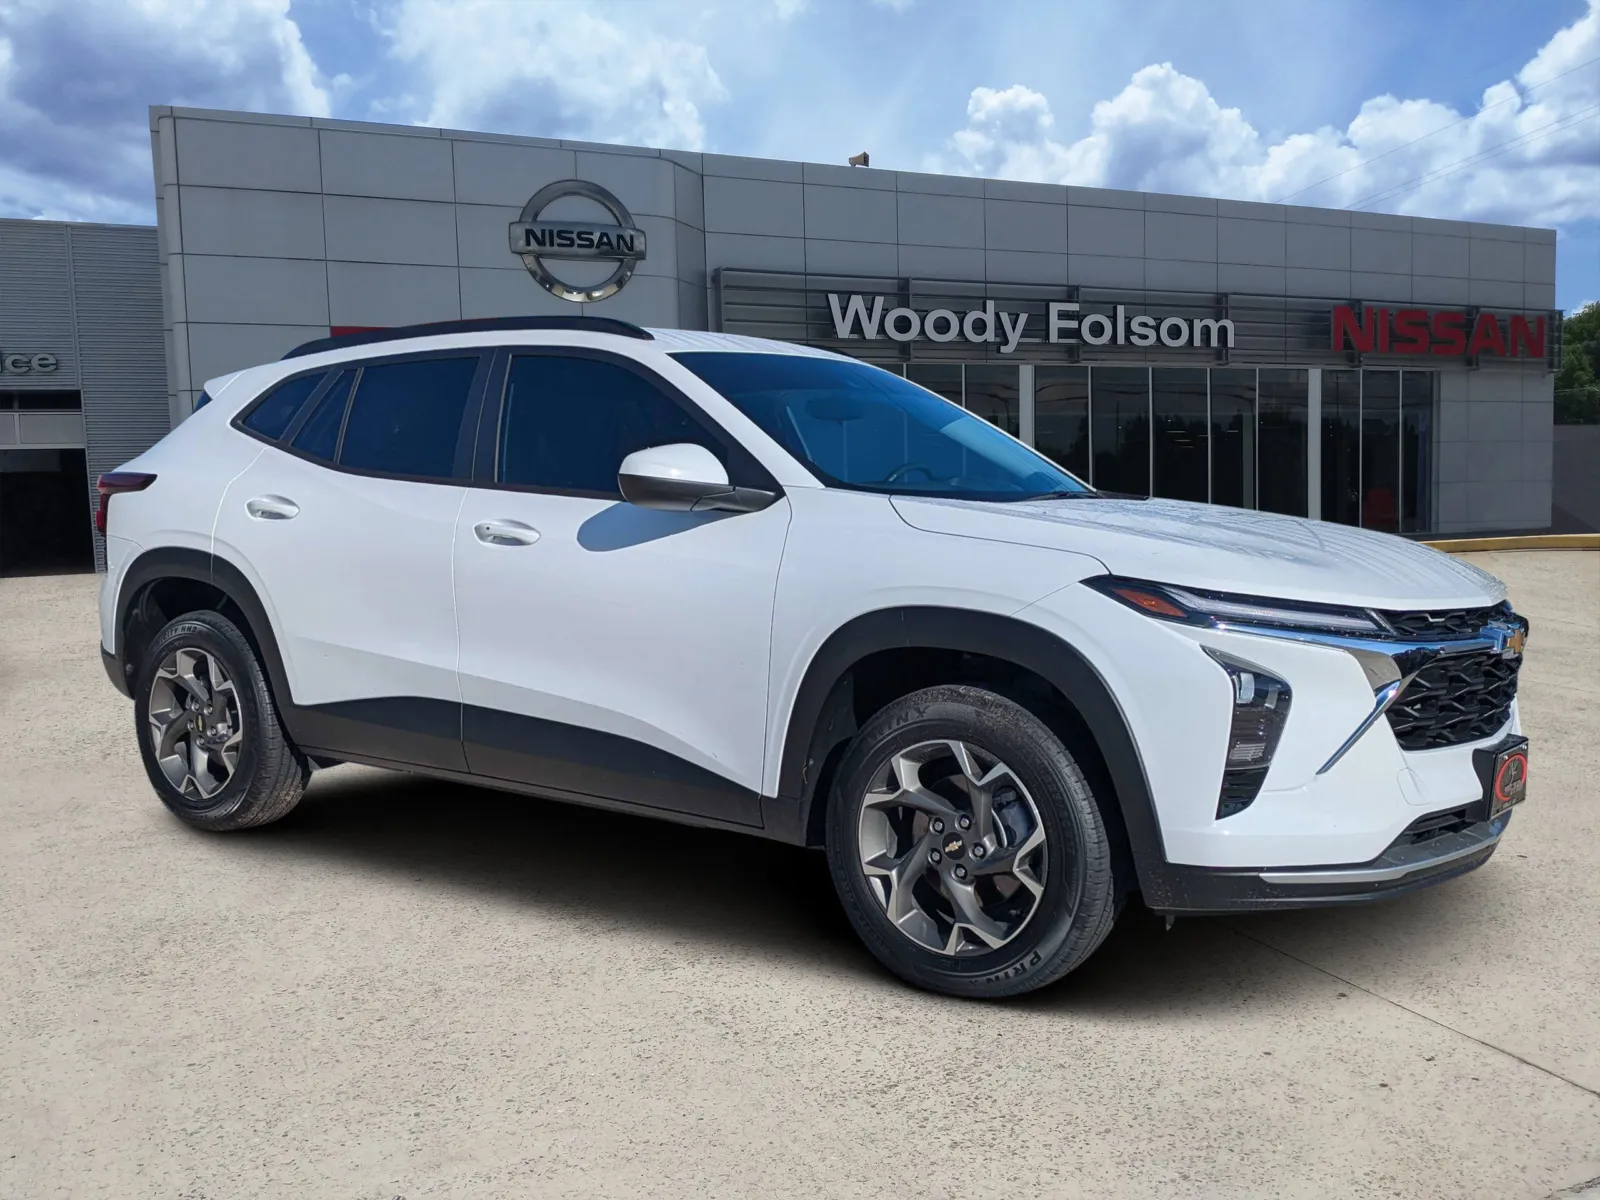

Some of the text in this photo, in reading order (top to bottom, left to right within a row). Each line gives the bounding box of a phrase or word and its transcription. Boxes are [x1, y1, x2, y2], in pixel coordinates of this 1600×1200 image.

[525, 228, 634, 252] NISSAN
[828, 293, 1235, 354] Woody Folsom
[1333, 305, 1545, 358] NISSAN
[0, 352, 57, 374] ce
